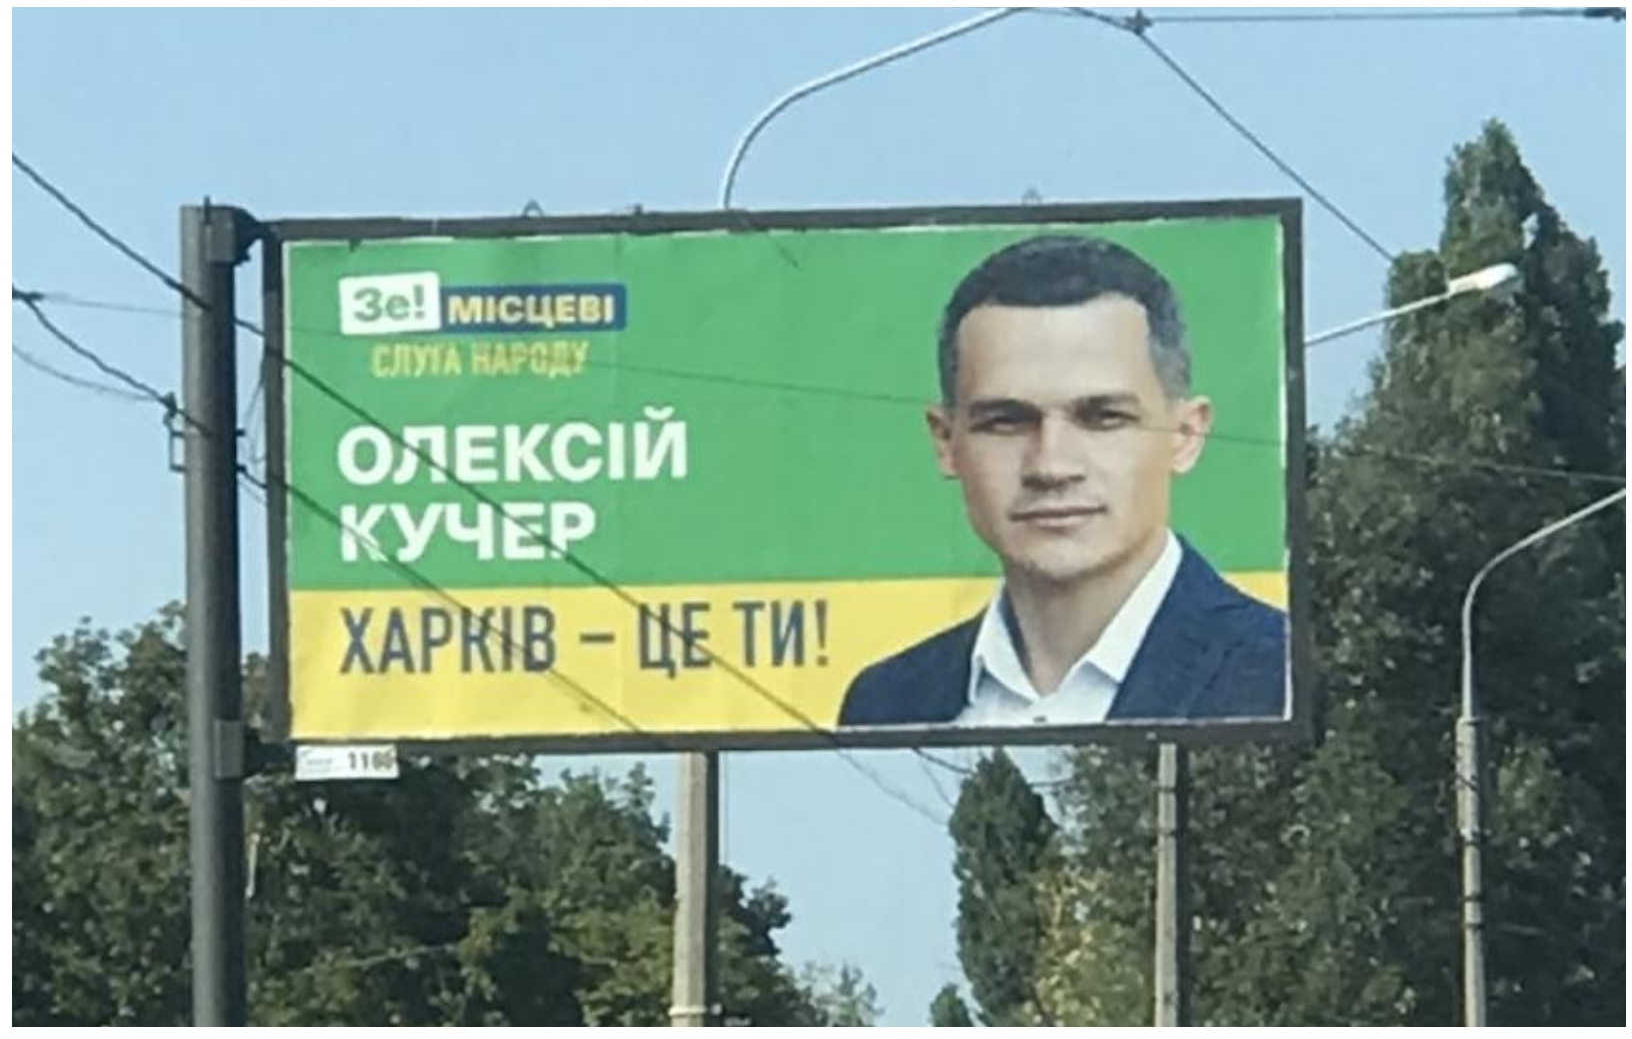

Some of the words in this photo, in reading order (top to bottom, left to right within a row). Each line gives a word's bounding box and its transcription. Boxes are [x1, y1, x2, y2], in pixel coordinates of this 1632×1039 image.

[353, 284, 425, 323] Зе!
[448, 293, 615, 329] МІСЦЕВІ
[371, 341, 463, 378] СЛУГА
[471, 339, 590, 379] НАРОДУ
[336, 405, 687, 485] ОЛЕКСІЙ
[340, 501, 597, 562] КУЧЕР
[339, 606, 556, 675] ХАРКІВ
[636, 601, 713, 680] ЦЕ
[732, 598, 830, 668] ТИ!
